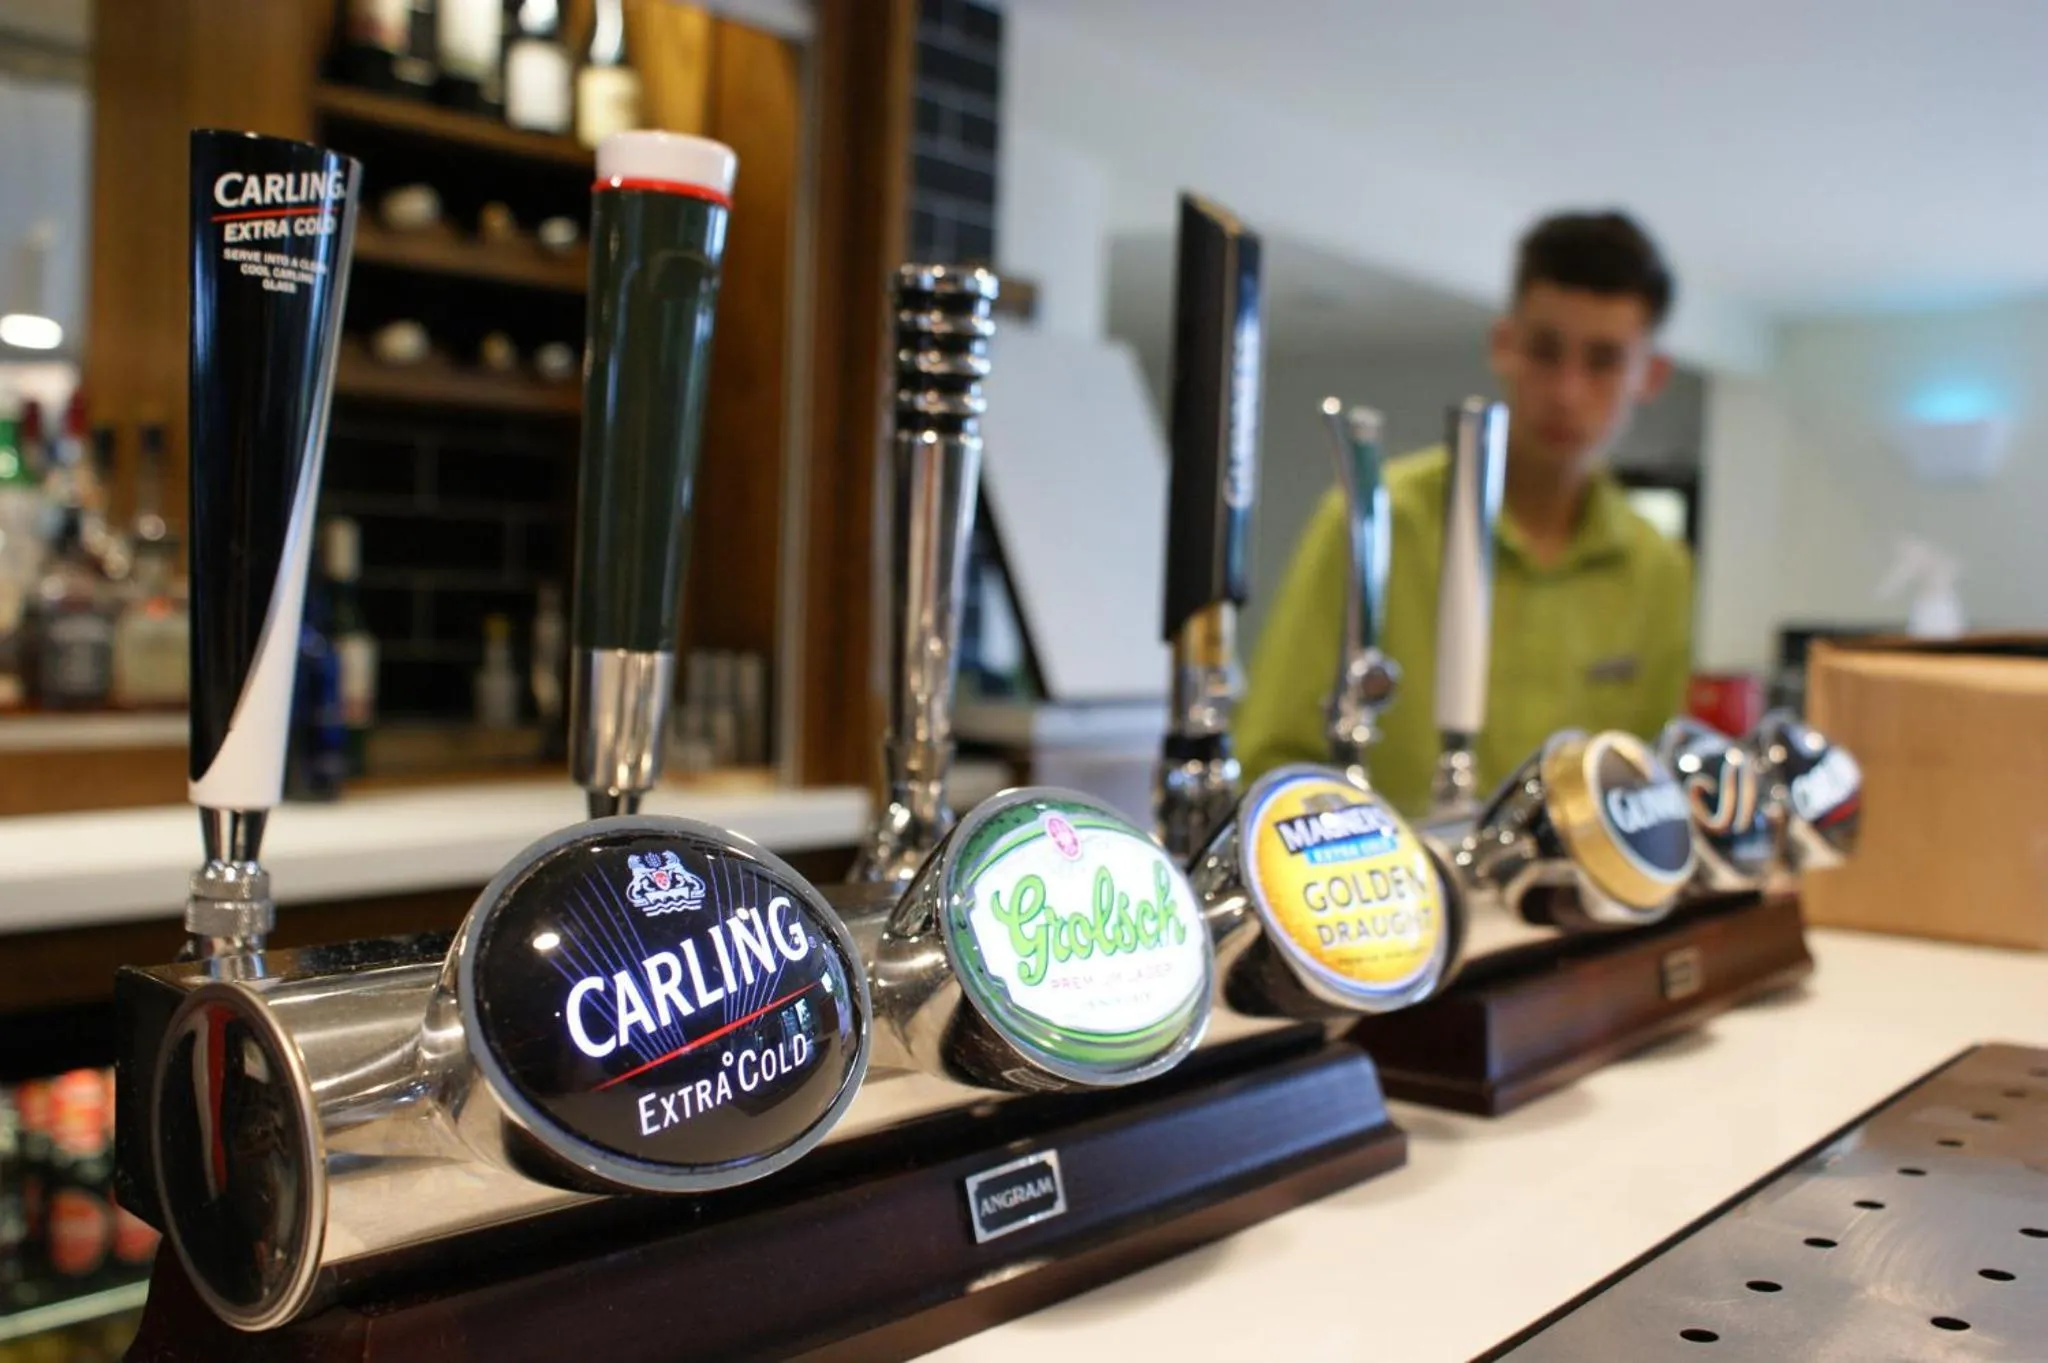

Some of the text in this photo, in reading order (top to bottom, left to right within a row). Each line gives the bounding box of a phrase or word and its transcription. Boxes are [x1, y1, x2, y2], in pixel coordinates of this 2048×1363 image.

[213, 171, 345, 208] CARLING
[223, 215, 337, 242] EXTRA COLD
[1302, 866, 1427, 913] GOLDEN
[989, 859, 1187, 987] Grolsch
[1315, 905, 1432, 947] DRAUGT
[566, 896, 809, 1058] CARLING
[1050, 970, 1122, 990] PREMUM
[637, 1034, 808, 1137] EXTRA COLD
[980, 1176, 1054, 1218] ANGRAM
